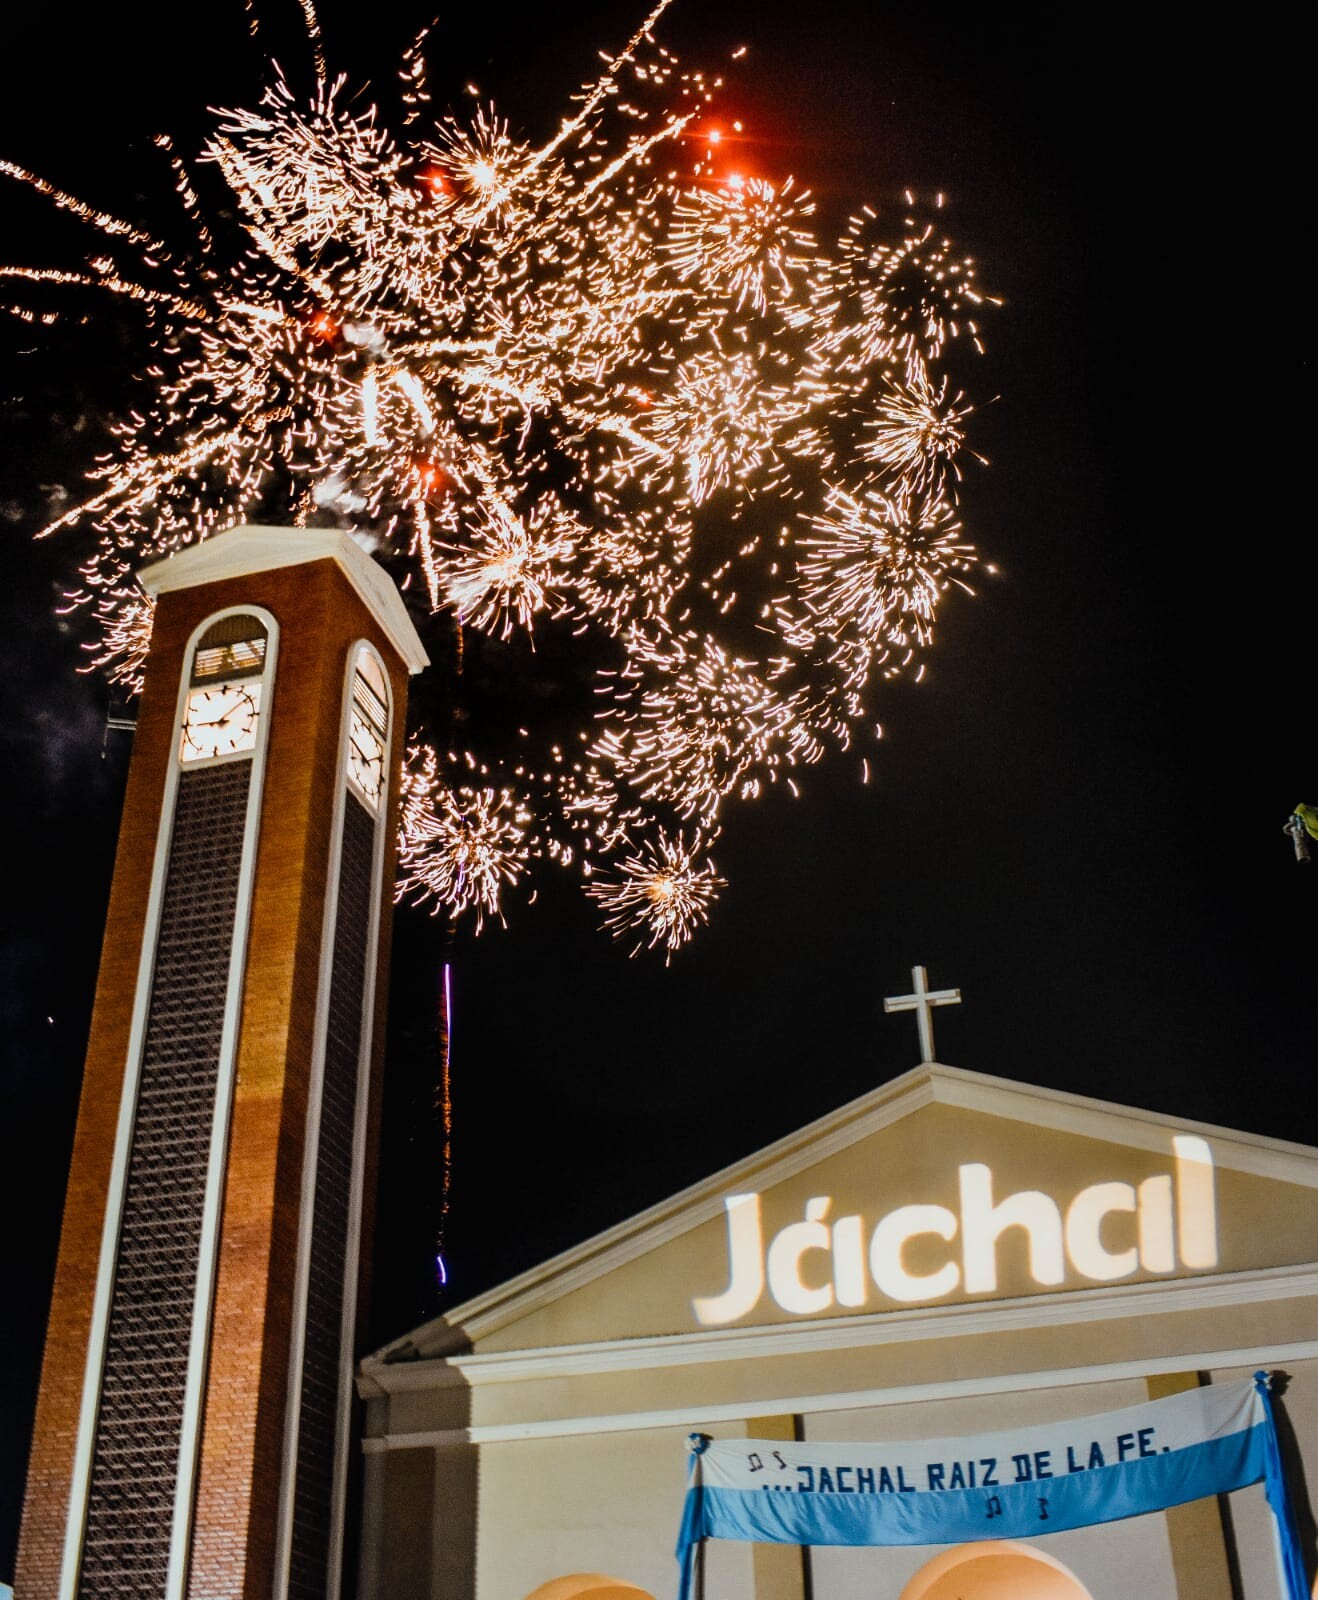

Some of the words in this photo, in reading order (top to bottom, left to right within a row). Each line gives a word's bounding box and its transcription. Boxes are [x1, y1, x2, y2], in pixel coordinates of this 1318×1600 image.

[692, 1135, 1218, 1326] Jáchal
[927, 1458, 999, 1490] RAIZ
[1012, 1450, 1054, 1482] DE
[1066, 1441, 1105, 1473] LA
[1116, 1427, 1171, 1463] FE.
